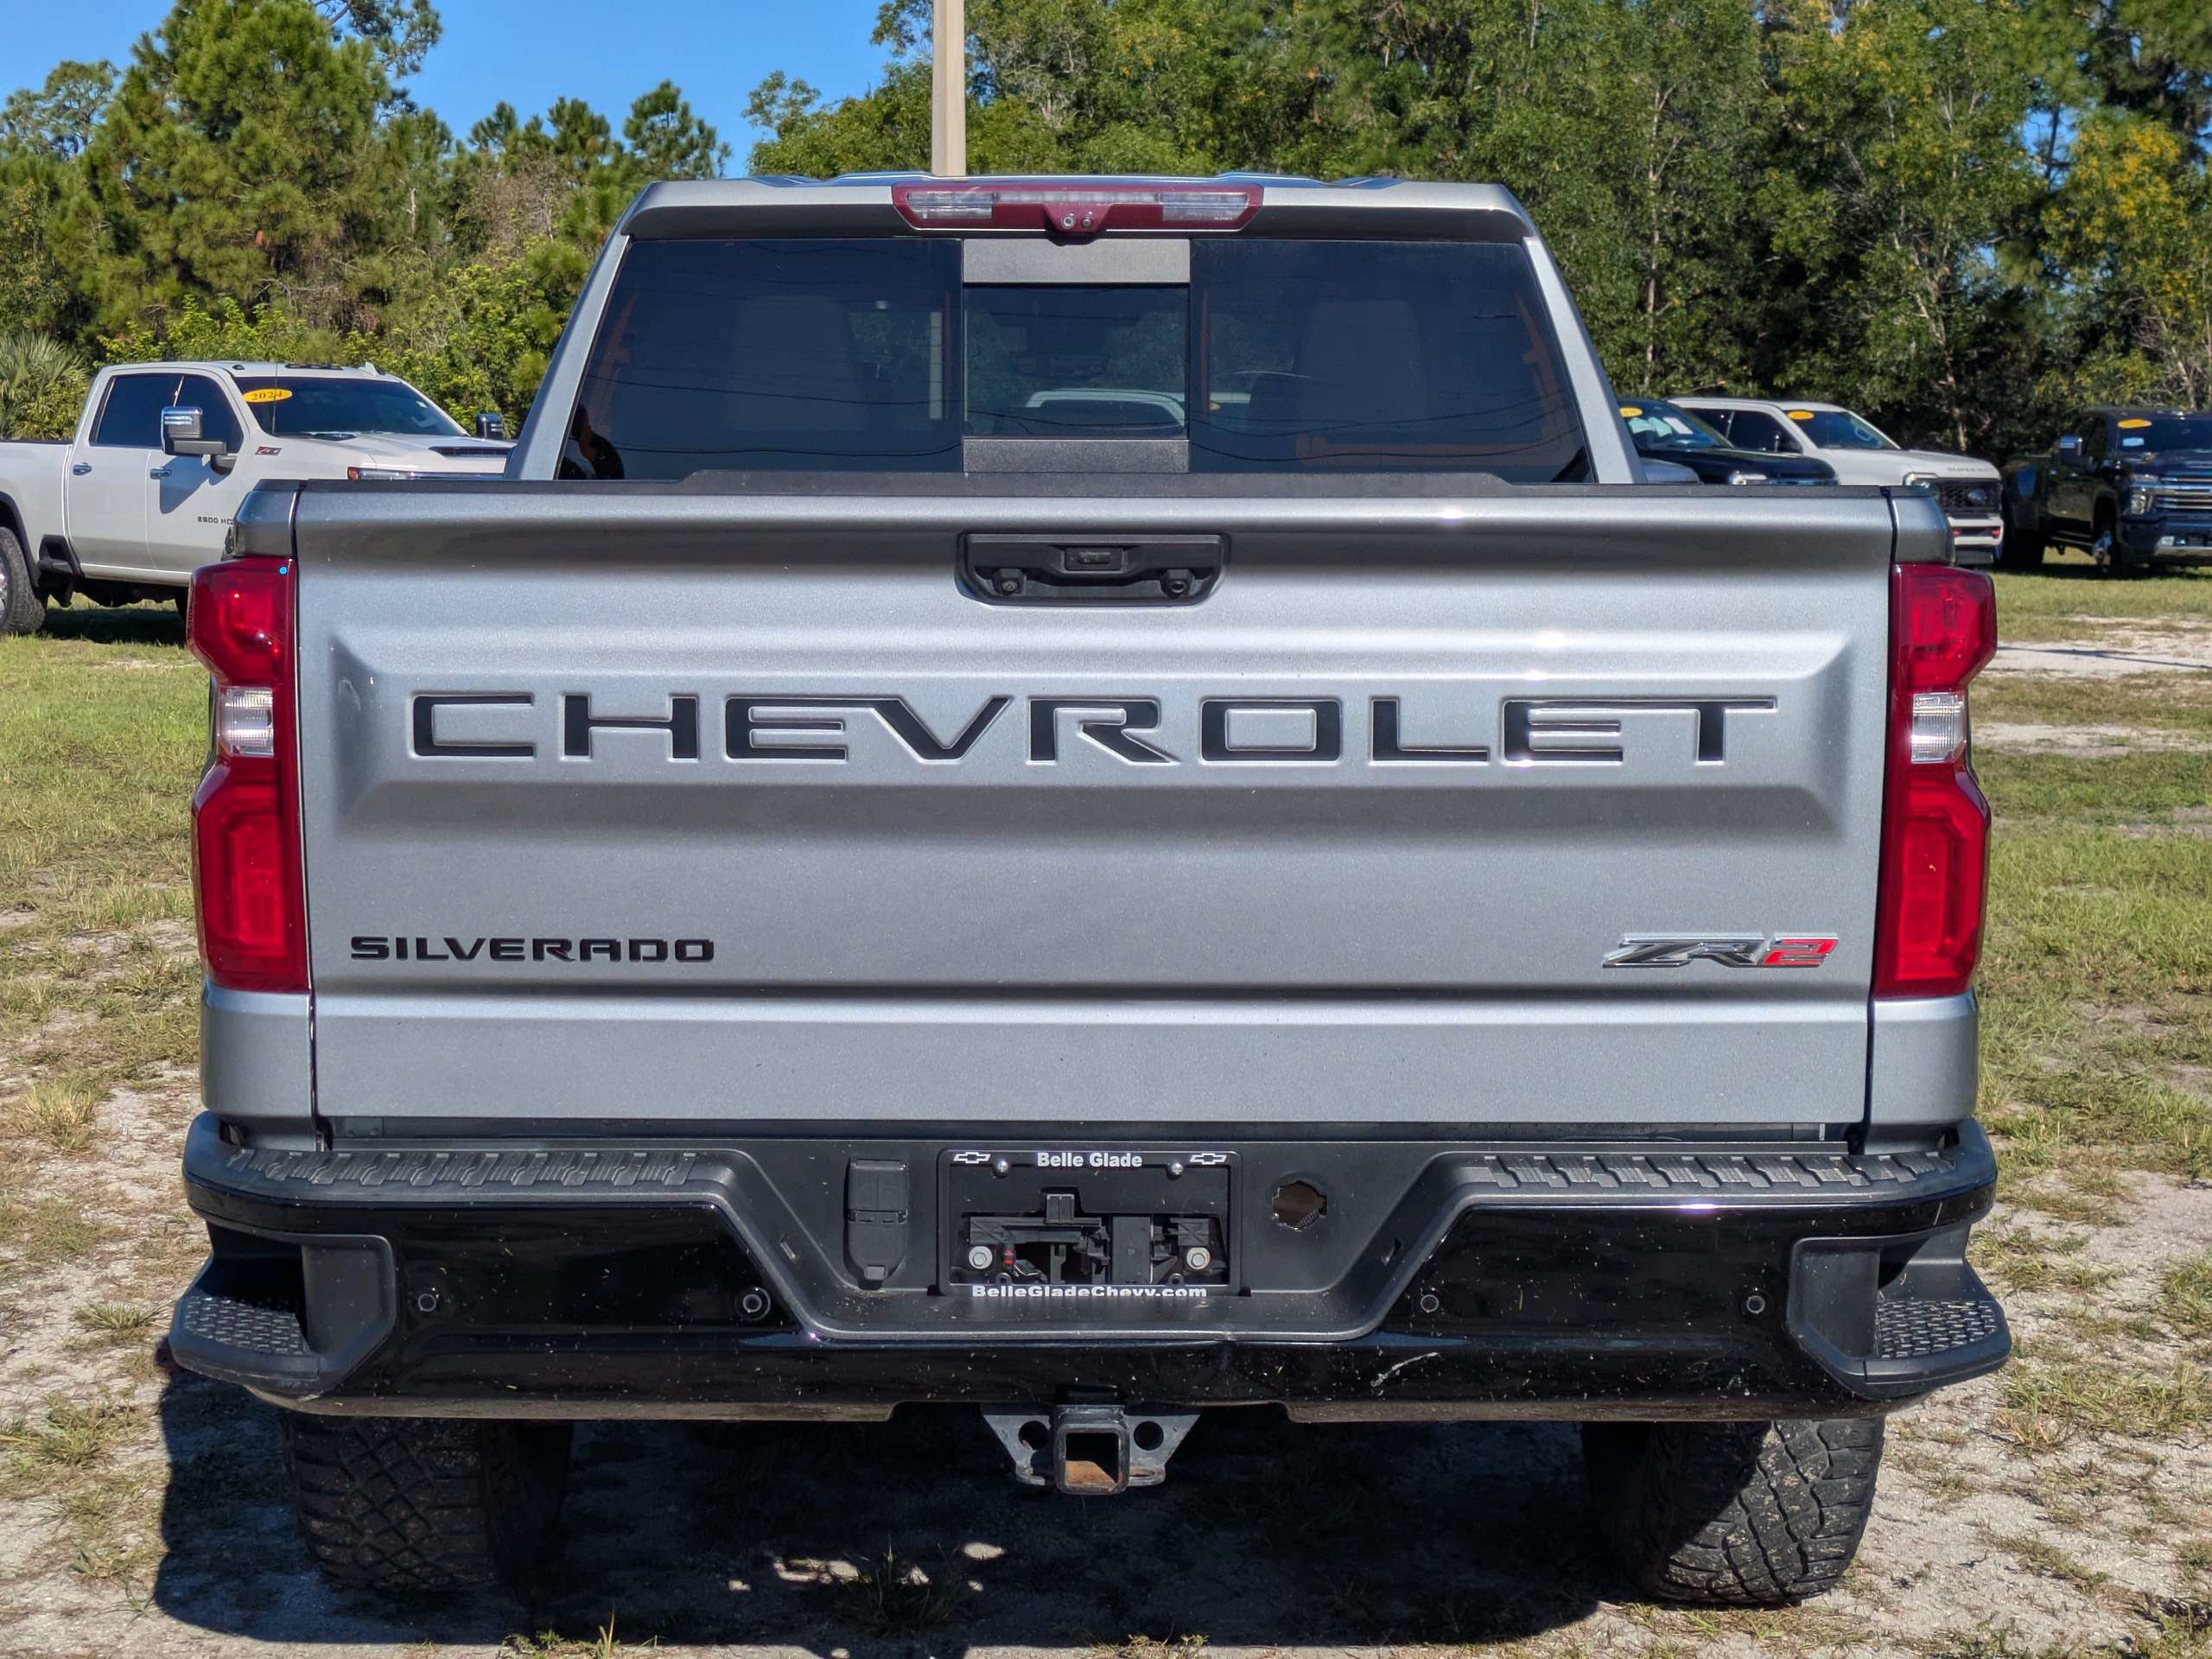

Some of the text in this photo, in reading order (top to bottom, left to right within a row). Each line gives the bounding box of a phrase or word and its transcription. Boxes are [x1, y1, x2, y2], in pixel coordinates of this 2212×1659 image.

[251, 391, 283, 401] 2024
[412, 693, 1777, 766] CHEVROLET
[350, 936, 715, 963] SILVERADO
[1602, 932, 1840, 969] ZR2
[1037, 1152, 1143, 1168] Belle Glade
[971, 1285, 1208, 1298] BelleGladeChevy.com
